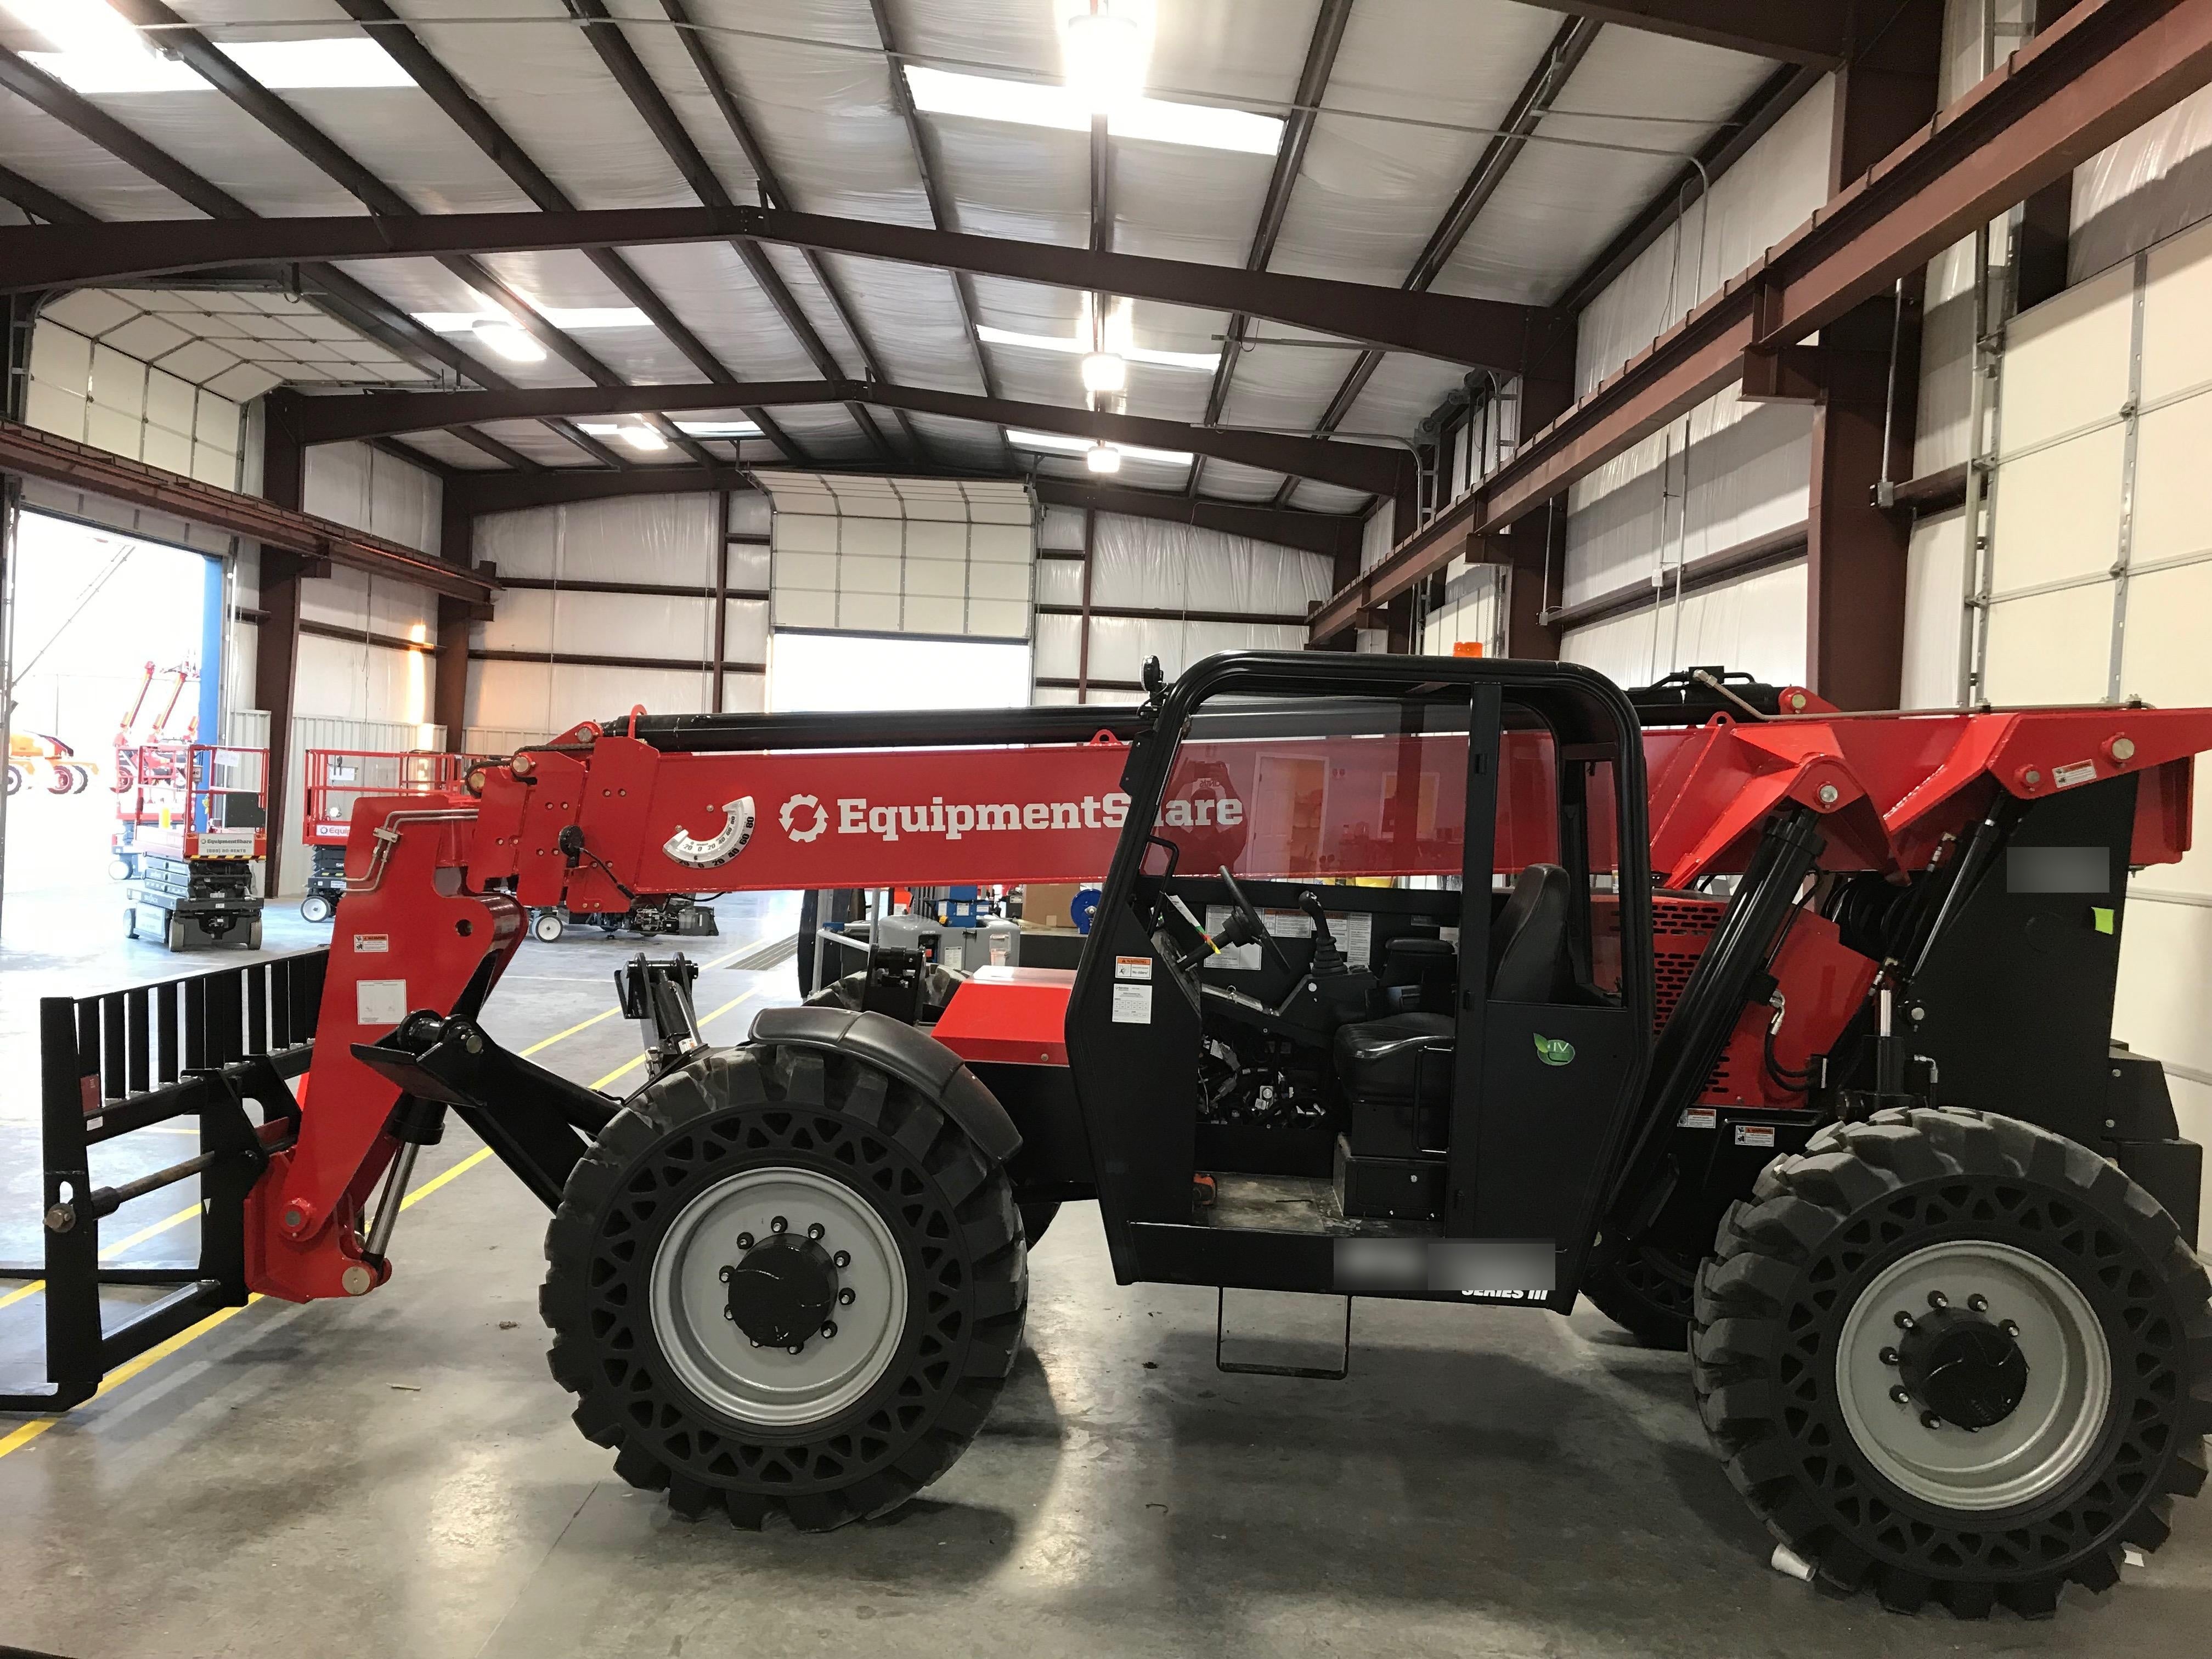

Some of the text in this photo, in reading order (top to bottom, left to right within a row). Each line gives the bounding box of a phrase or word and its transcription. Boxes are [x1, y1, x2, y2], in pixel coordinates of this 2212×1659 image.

[712, 858, 725, 866] 20
[728, 848, 740, 858] 40
[740, 833, 750, 845] 60
[746, 816, 754, 828] 80
[726, 827, 732, 836] 60
[837, 792, 1243, 841] EquipmentSare
